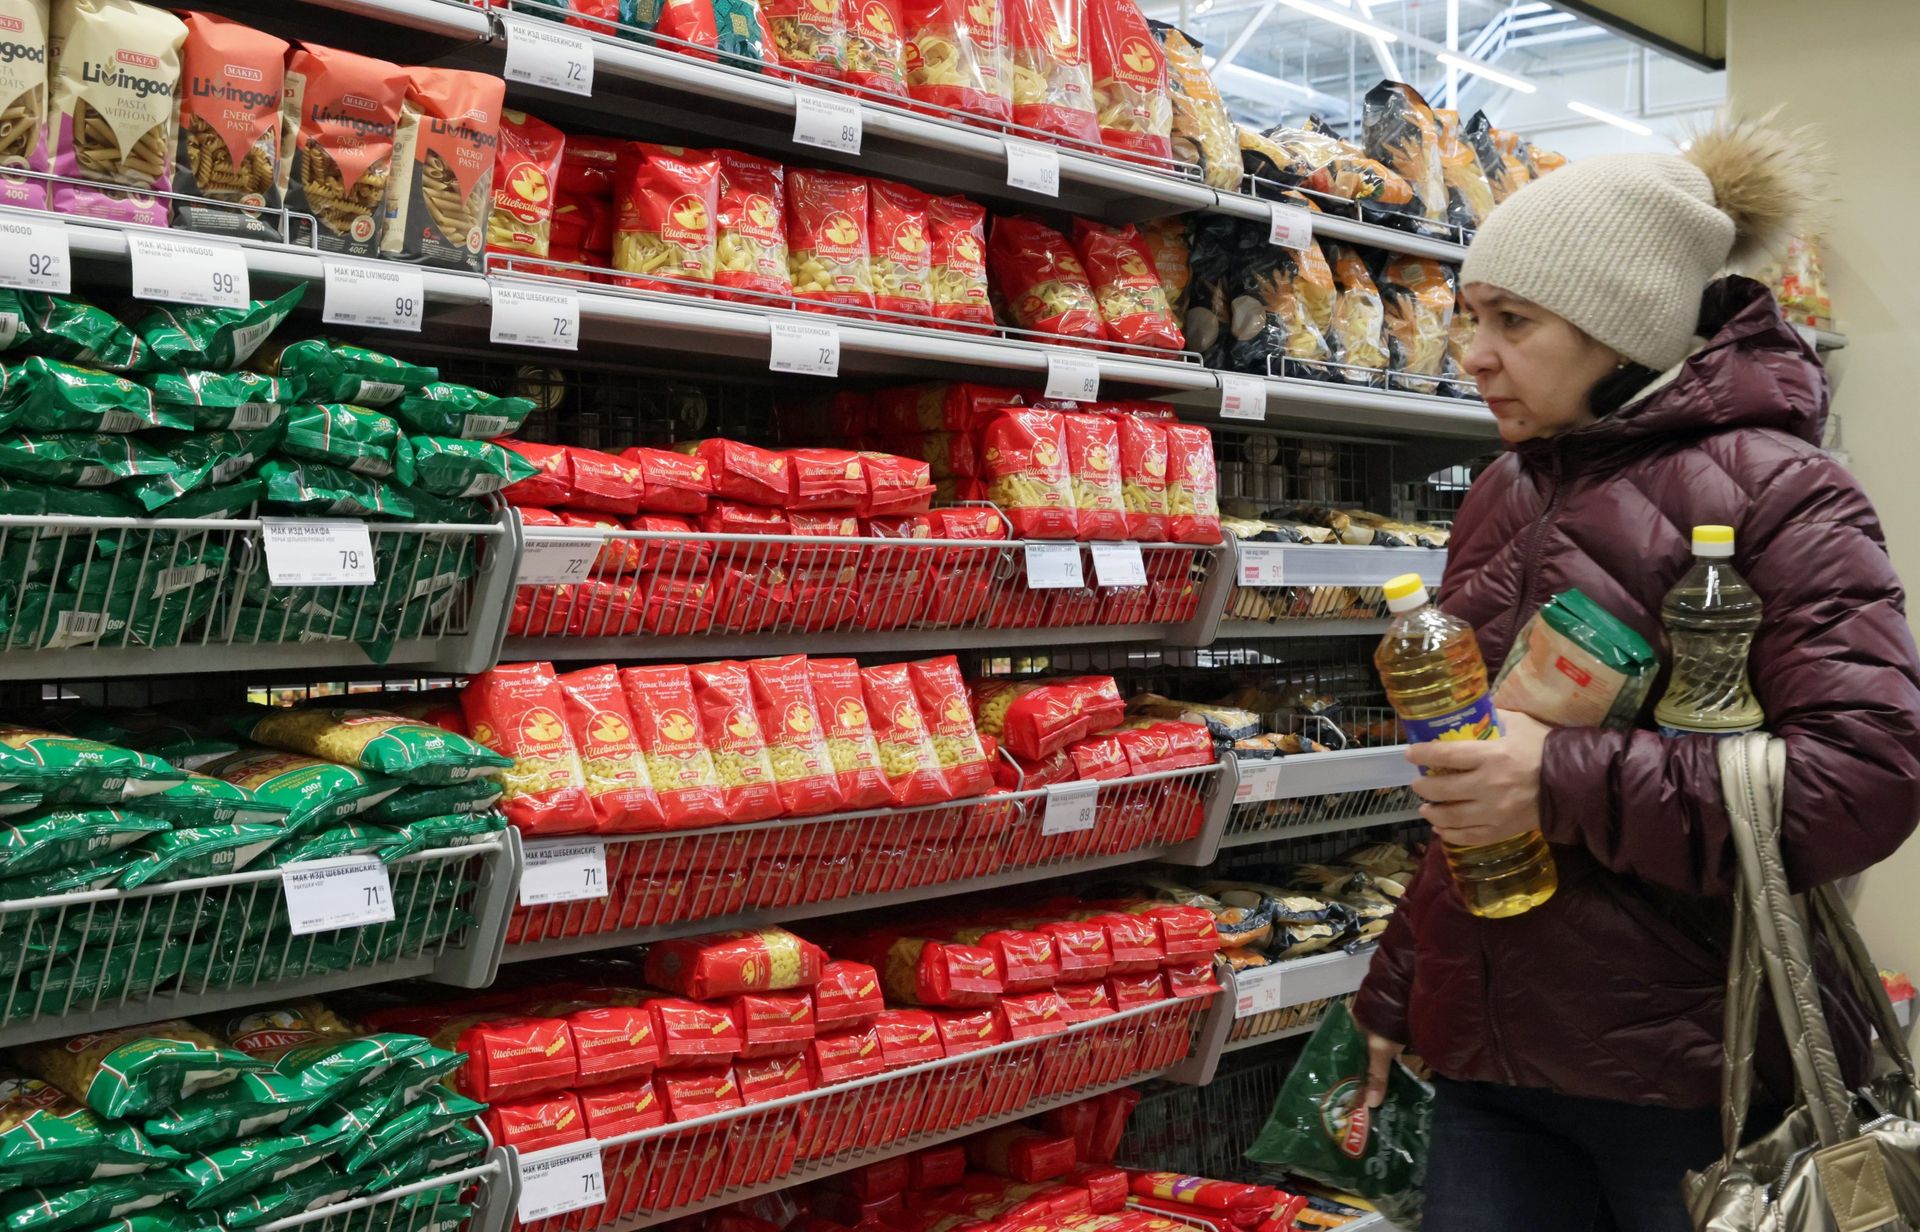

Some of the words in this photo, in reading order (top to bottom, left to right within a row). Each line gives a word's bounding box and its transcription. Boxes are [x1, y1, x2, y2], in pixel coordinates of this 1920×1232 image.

[512, 26, 527, 37] МАК
[527, 30, 540, 40] ИЗД
[540, 32, 583, 50] ШЕБЕКИНСКИЕ
[119, 52, 156, 67] MAKFA
[227, 68, 260, 81] MAKFA
[566, 61, 582, 81] 72
[117, 96, 147, 111] PASTA
[344, 97, 375, 111] MAKFA
[226, 120, 255, 134] PASTA
[841, 125, 854, 142] 89
[336, 146, 365, 159] PASTA
[457, 157, 480, 170] PASTA
[5, 188, 29, 201] 400г
[132, 213, 155, 224] 400г
[0, 225, 32, 236] INGOOD
[138, 240, 155, 250] МАК
[157, 243, 174, 253] ИЗД
[174, 245, 214, 257] LIVINGOOD
[348, 246, 368, 256] 400г
[29, 253, 53, 277] 92
[334, 266, 349, 276] МАК
[350, 268, 365, 279] ИЗД
[365, 272, 399, 283] LIVINGOOD
[212, 272, 233, 294] 99
[498, 290, 512, 300] МАК
[512, 292, 525, 302] ИЗД
[525, 293, 568, 306] ШЕБЕКИНСКИЕ
[395, 297, 414, 317] 99
[552, 317, 568, 336] 72
[818, 347, 831, 365] 72
[1083, 378, 1094, 393] 89
[270, 526, 286, 537] МАК
[287, 526, 303, 539] ИЗД
[304, 526, 331, 538] МАКФА
[339, 551, 359, 570] 79
[564, 559, 583, 574] 72
[1064, 563, 1075, 577] 72
[108, 619, 126, 630] 450
[78, 752, 104, 763] 400г
[102, 777, 124, 789] 400
[300, 783, 322, 797] 400г
[213, 808, 235, 821] 400
[336, 806, 358, 818] 400
[1079, 808, 1091, 822] 89
[88, 837, 111, 851] 400
[449, 836, 470, 847] 400
[212, 854, 235, 867] 400
[525, 851, 539, 860] МАК
[540, 850, 552, 859] ИЗД
[553, 846, 596, 858] ШЕБЕКИНСКИЕ
[292, 874, 308, 885] МАК
[309, 871, 324, 882] ИЗД
[325, 865, 377, 879] ШЕБЕКИНСКИЕ
[583, 868, 597, 886] 71
[363, 886, 380, 906] 71
[750, 1011, 791, 1024] Шебекинские
[582, 1033, 631, 1051] Шебекинские
[321, 1053, 344, 1067] 450г
[491, 1044, 545, 1062] Шебекинские
[673, 1086, 716, 1101] Шебекинские
[591, 1101, 636, 1119] Шебекинские
[507, 1118, 555, 1136] Шебекинские
[522, 1164, 536, 1175] МАК
[537, 1161, 550, 1172] ИЗД
[550, 1152, 594, 1168] ШЕБЕКИНСКИЕ
[582, 1173, 597, 1193] 71
